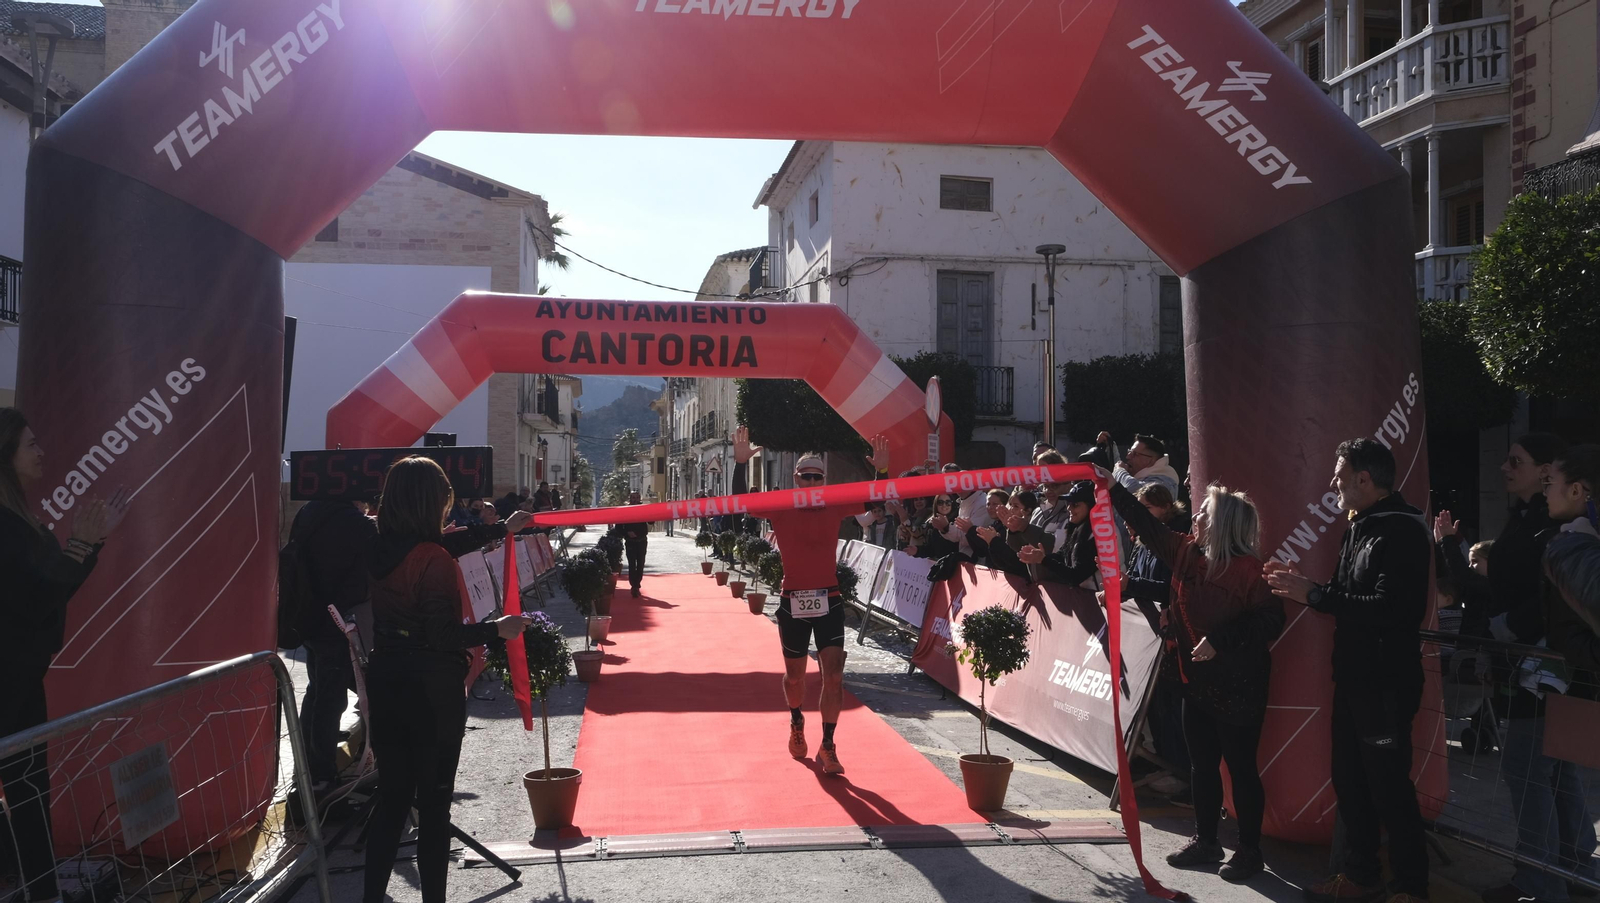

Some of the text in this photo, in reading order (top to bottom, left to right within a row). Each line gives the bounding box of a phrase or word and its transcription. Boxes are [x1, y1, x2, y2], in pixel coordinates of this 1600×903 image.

[153, 0, 345, 171] TEAMERGY
[1126, 24, 1313, 190] TEAMERGY
[535, 300, 767, 324] AYUNTAMIENTO
[541, 329, 758, 368] CANTORIA
[667, 466, 1056, 519] TRAIL DE LA POLVORA
[798, 598, 822, 611] 326
